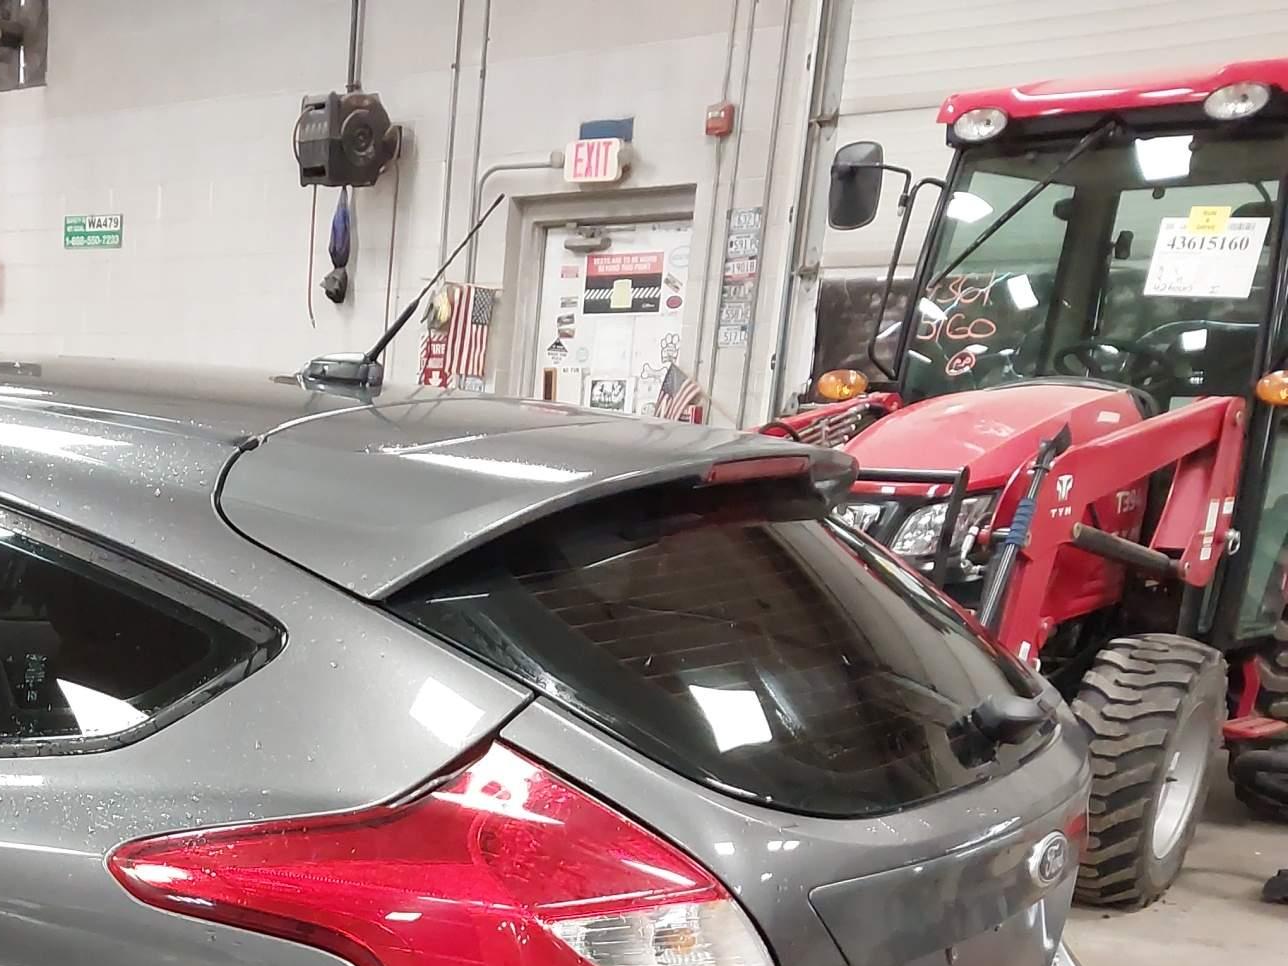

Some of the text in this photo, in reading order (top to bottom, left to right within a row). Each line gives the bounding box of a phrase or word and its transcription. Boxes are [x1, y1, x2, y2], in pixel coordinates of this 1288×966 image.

[573, 141, 612, 177] EXIT
[88, 217, 119, 229] WA479
[1167, 236, 1250, 251] 43615160
[1050, 506, 1072, 518] TYM
